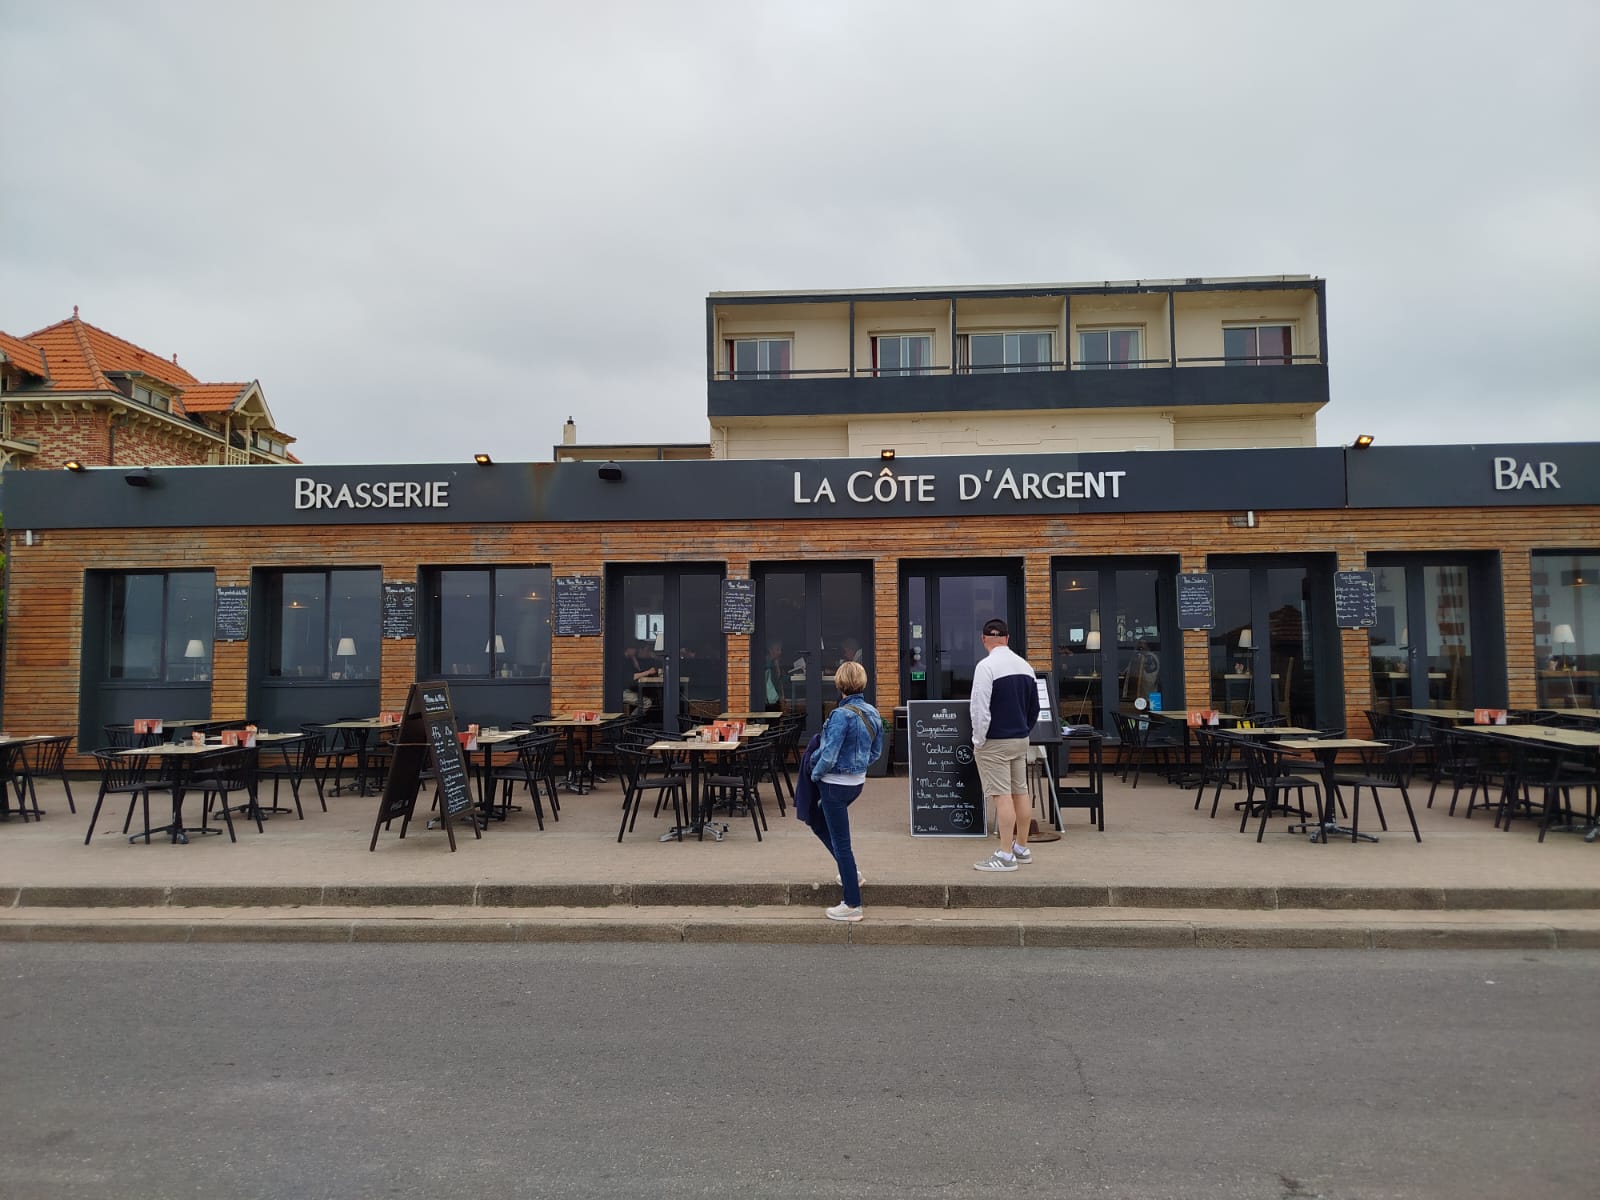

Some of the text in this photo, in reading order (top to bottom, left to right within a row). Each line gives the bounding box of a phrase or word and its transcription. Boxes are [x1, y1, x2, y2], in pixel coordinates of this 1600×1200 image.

[794, 472, 836, 503] LA
[847, 467, 936, 503] CÔTE
[1494, 457, 1561, 490] BAR
[295, 478, 449, 509] BRASSERIE
